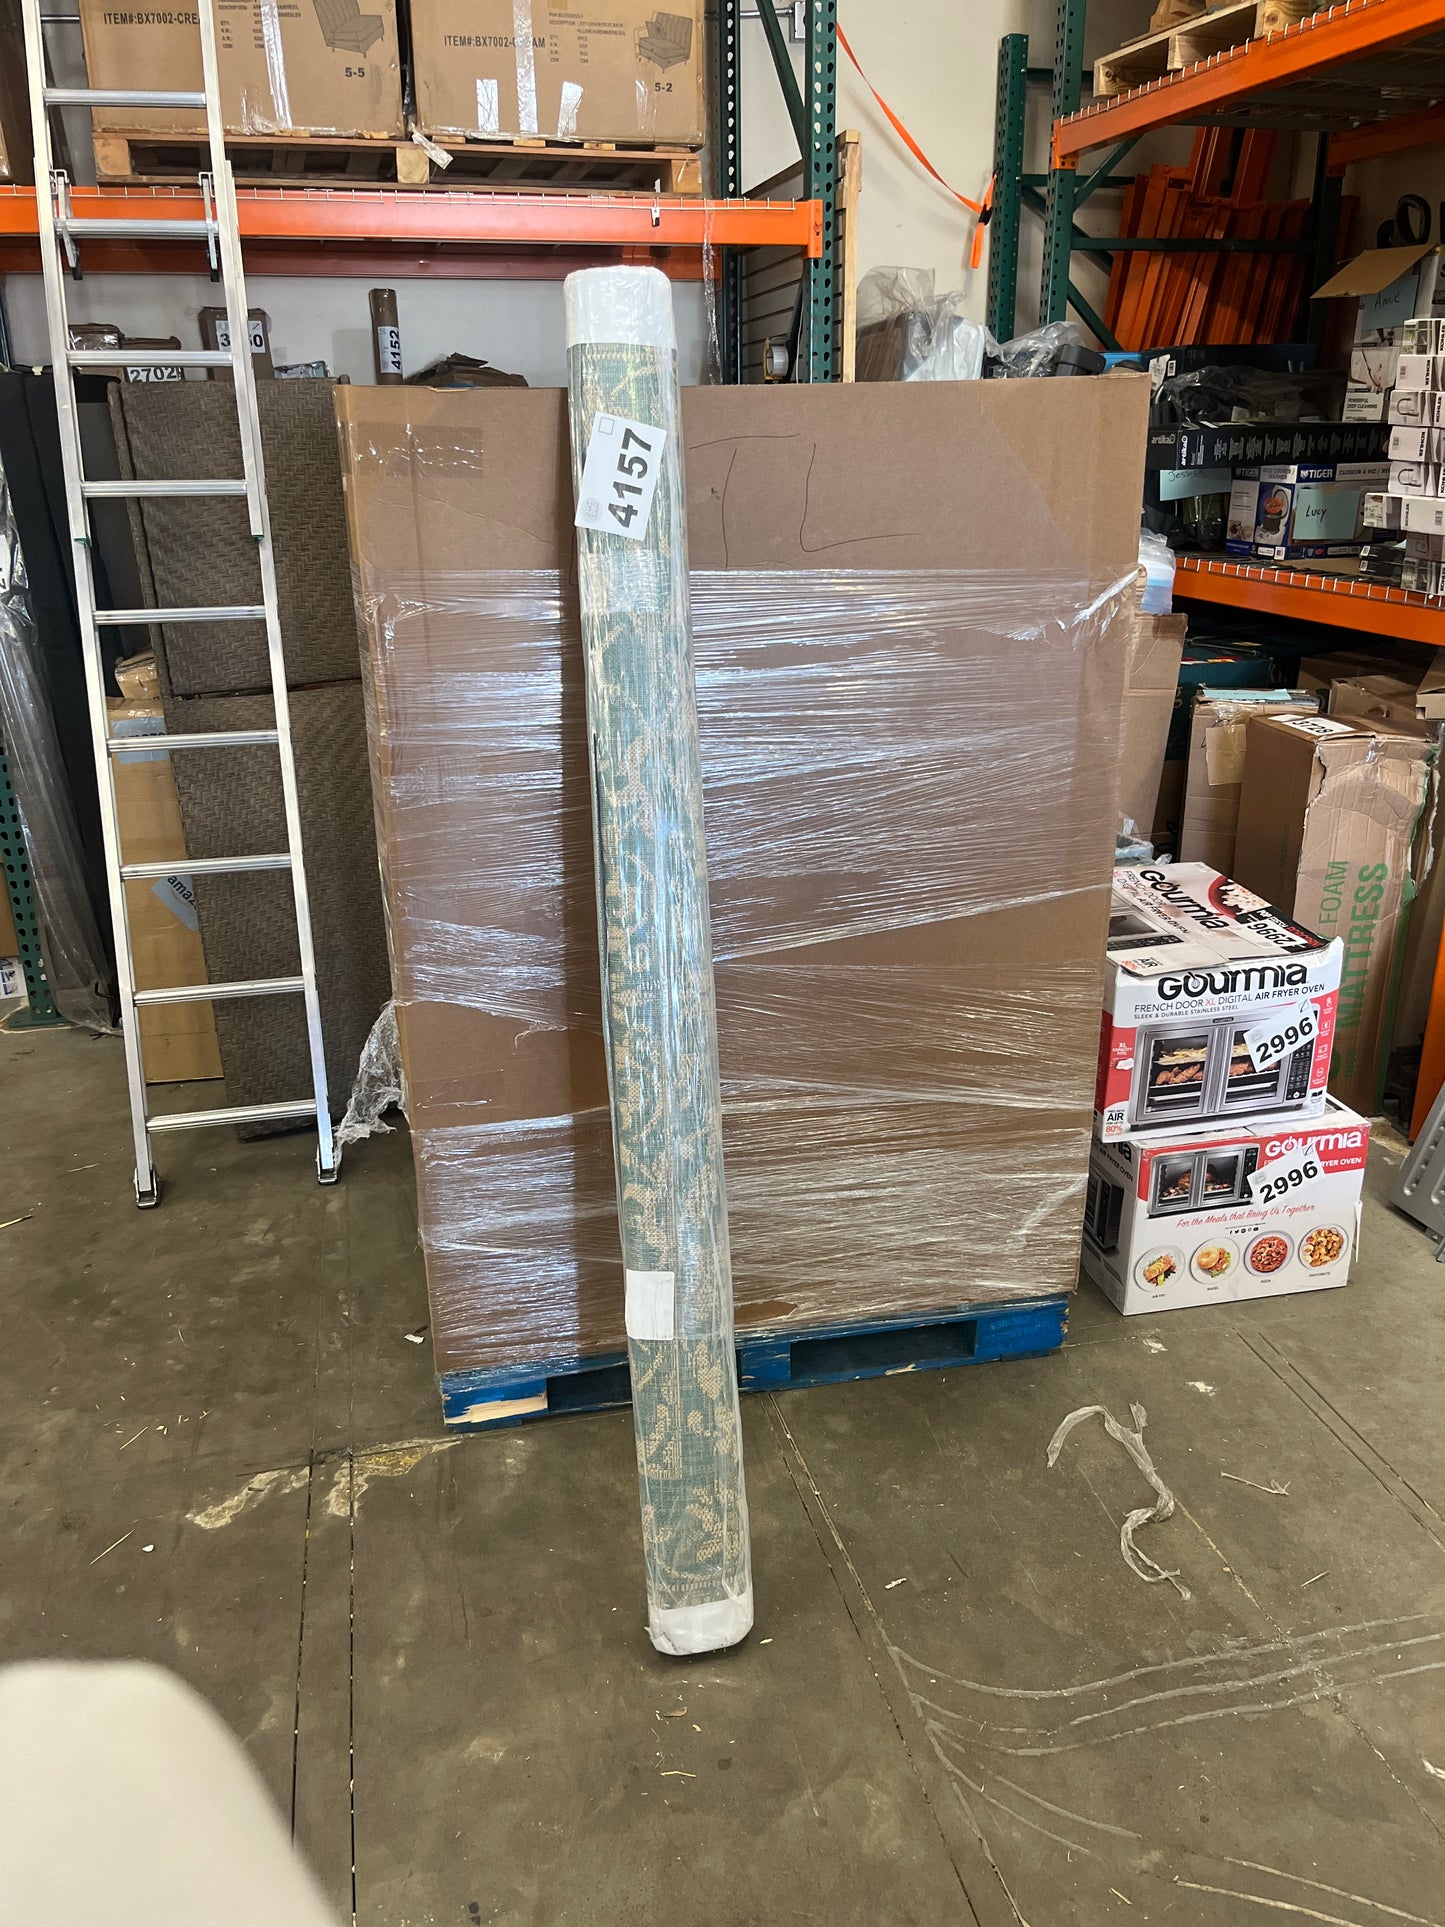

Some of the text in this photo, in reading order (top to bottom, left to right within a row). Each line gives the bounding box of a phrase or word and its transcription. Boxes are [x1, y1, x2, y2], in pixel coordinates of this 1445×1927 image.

[104, 13, 200, 25] ITEM#:BX7002-CRE
[444, 35, 546, 48] ITEM#:BX7002-AM
[344, 67, 366, 78] 5-5
[654, 83, 673, 92] 5-2
[220, 333, 264, 348] 30
[390, 330, 401, 370] 4152
[129, 366, 177, 383] 2702
[1418, 431, 1426, 457] KOHLER
[608, 427, 653, 528] 4157
[1241, 468, 1259, 478] TIGER
[1309, 469, 1333, 479] TIGER
[1306, 505, 1327, 523] Lucy
[1292, 721, 1334, 734] 3728
[167, 875, 197, 910] amaz
[1140, 870, 1229, 929] Gourmia
[1317, 860, 1350, 925] FOAM
[1247, 921, 1297, 945] 2996
[1335, 862, 1389, 1029] MATTRESS
[1158, 963, 1308, 1001] Gourmia
[1134, 984, 1325, 1013] FRENCH DOOR XL DIGITAL AIR FRYER OVEN
[1190, 1006, 1221, 1015] STAINLESS
[1255, 1016, 1313, 1064] 2996
[1107, 1112, 1124, 1122] AIR
[1105, 1125, 1123, 1133] 80%
[1320, 1157, 1362, 1168] RYER OVEN
[1120, 1166, 1134, 1182] OVEN
[1259, 1160, 1318, 1204] 2996
[1176, 1204, 1316, 1229] For the Meals that Bring Us Together
